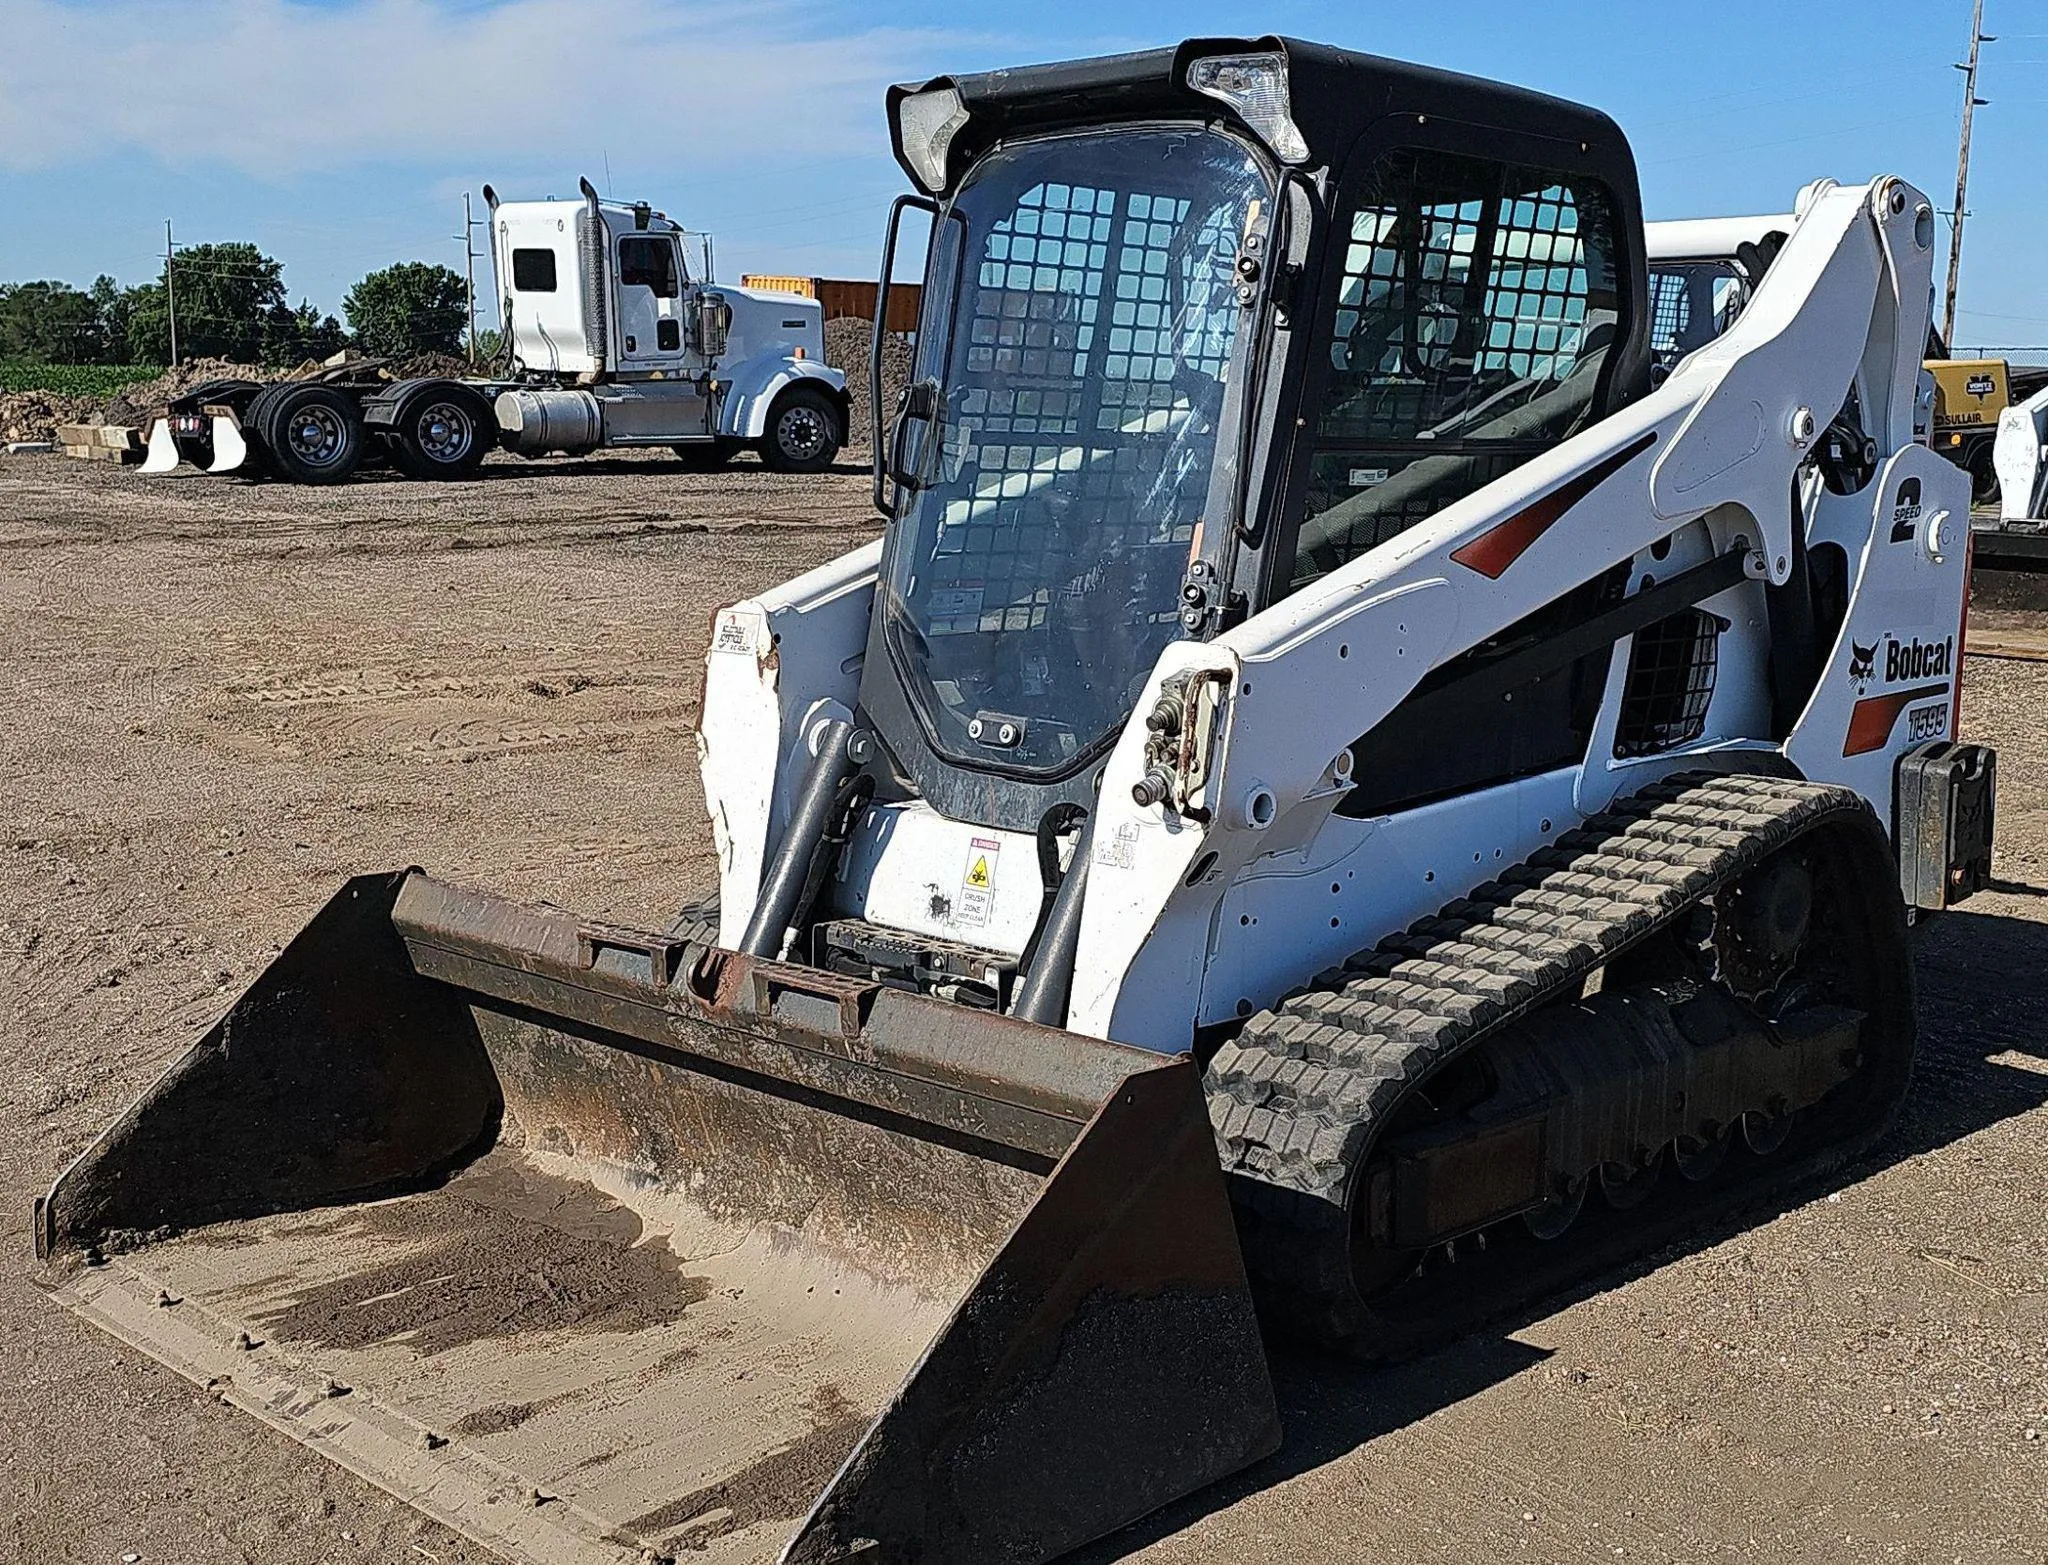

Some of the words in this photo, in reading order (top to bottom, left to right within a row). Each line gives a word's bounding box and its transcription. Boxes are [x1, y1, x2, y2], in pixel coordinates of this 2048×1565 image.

[1945, 413, 1982, 425] SULLAIR
[1893, 505, 1922, 521] SPEED
[1885, 635, 1952, 682] Bobcat
[1908, 702, 1948, 742] T595
[965, 893, 986, 903] CRUSH
[963, 904, 981, 914] ZONE
